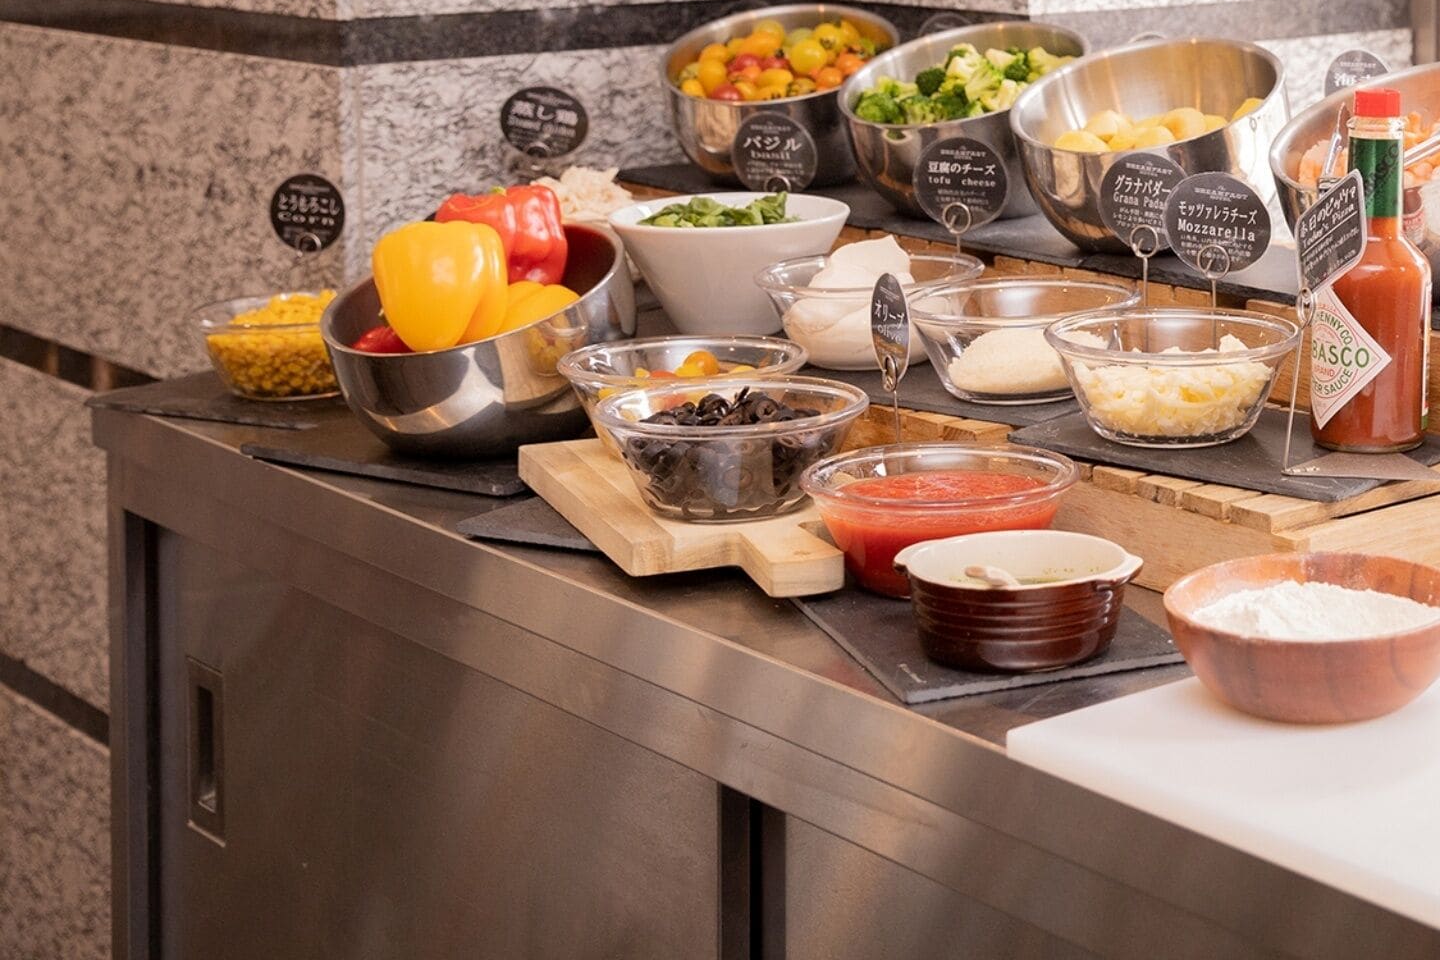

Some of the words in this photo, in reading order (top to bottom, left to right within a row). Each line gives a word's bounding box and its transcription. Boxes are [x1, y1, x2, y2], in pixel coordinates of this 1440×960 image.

[743, 135, 802, 152] バジル
[927, 160, 997, 176] 豆腐のチーズ
[928, 175, 951, 185] tofu
[961, 178, 996, 188] cheese
[279, 192, 341, 216] とうもろこし
[1112, 191, 1139, 206] Grana
[1178, 200, 1259, 226] モッツァレラチーズ
[1331, 203, 1355, 225] Pizza
[1177, 217, 1256, 243] Mozzarella
[1323, 368, 1354, 396] SAUCE
